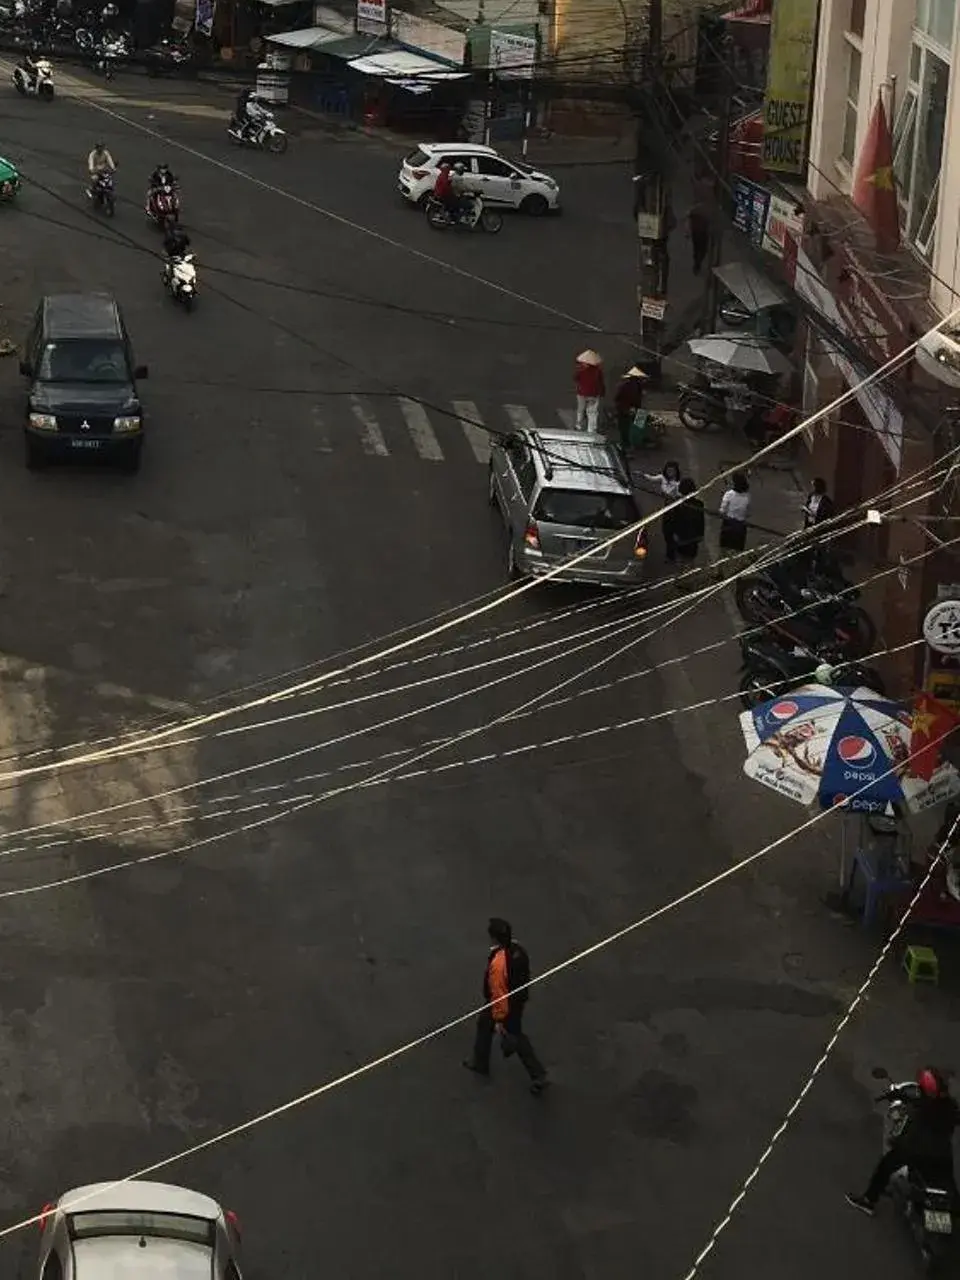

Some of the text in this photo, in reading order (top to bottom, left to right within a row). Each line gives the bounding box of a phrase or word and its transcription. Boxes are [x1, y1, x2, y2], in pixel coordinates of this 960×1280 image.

[767, 99, 806, 128] GUEST
[762, 134, 802, 164] HOUSE
[843, 769, 877, 782] pepsi
